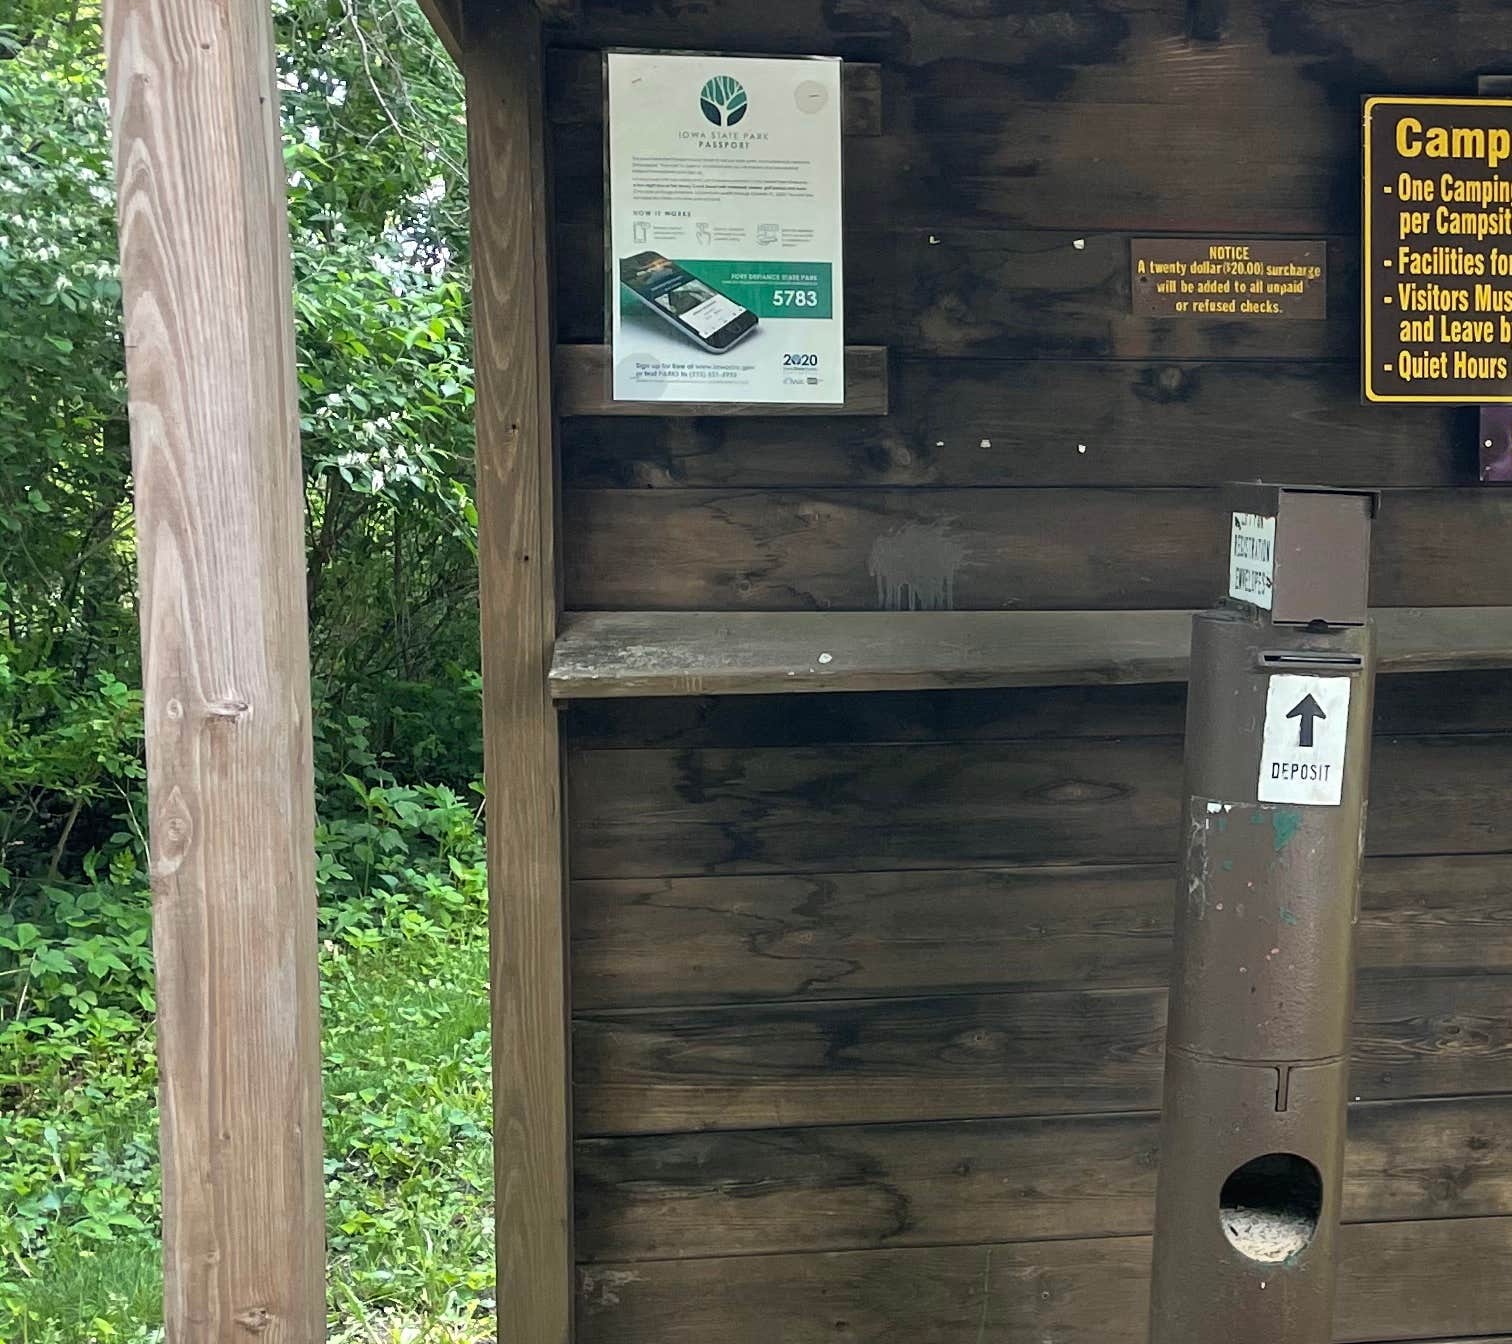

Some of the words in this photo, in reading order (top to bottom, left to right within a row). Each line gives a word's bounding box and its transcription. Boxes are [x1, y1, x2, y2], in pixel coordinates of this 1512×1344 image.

[698, 141, 750, 149] PASSPORT
[711, 131, 737, 139] STATE
[744, 132, 768, 140] PARK
[1398, 172, 1434, 202] One
[1399, 212, 1430, 239] per
[1209, 246, 1249, 260] NOTICE
[1398, 247, 1484, 276] Facilities
[1138, 260, 1145, 273] A
[1150, 261, 1186, 276] twenty
[1190, 261, 1220, 274] dollar
[1223, 262, 1263, 275] ($20.00)
[1266, 263, 1321, 279] surcharge
[1157, 280, 1176, 293] will
[1181, 281, 1194, 293] be
[1198, 281, 1230, 293] added
[1235, 281, 1246, 293] to
[1250, 281, 1263, 293] all
[1267, 281, 1303, 295] unpaid
[773, 290, 817, 306] 5783
[1176, 302, 1188, 311] or
[1193, 300, 1235, 312] refused
[1241, 300, 1283, 313] checks.
[1398, 283, 1468, 313] Visitors
[1399, 315, 1434, 343] and
[1440, 316, 1494, 344] Leave
[1398, 350, 1448, 382] Quiet
[1453, 350, 1507, 380] Hours
[1271, 762, 1331, 781] DEPOSIT
